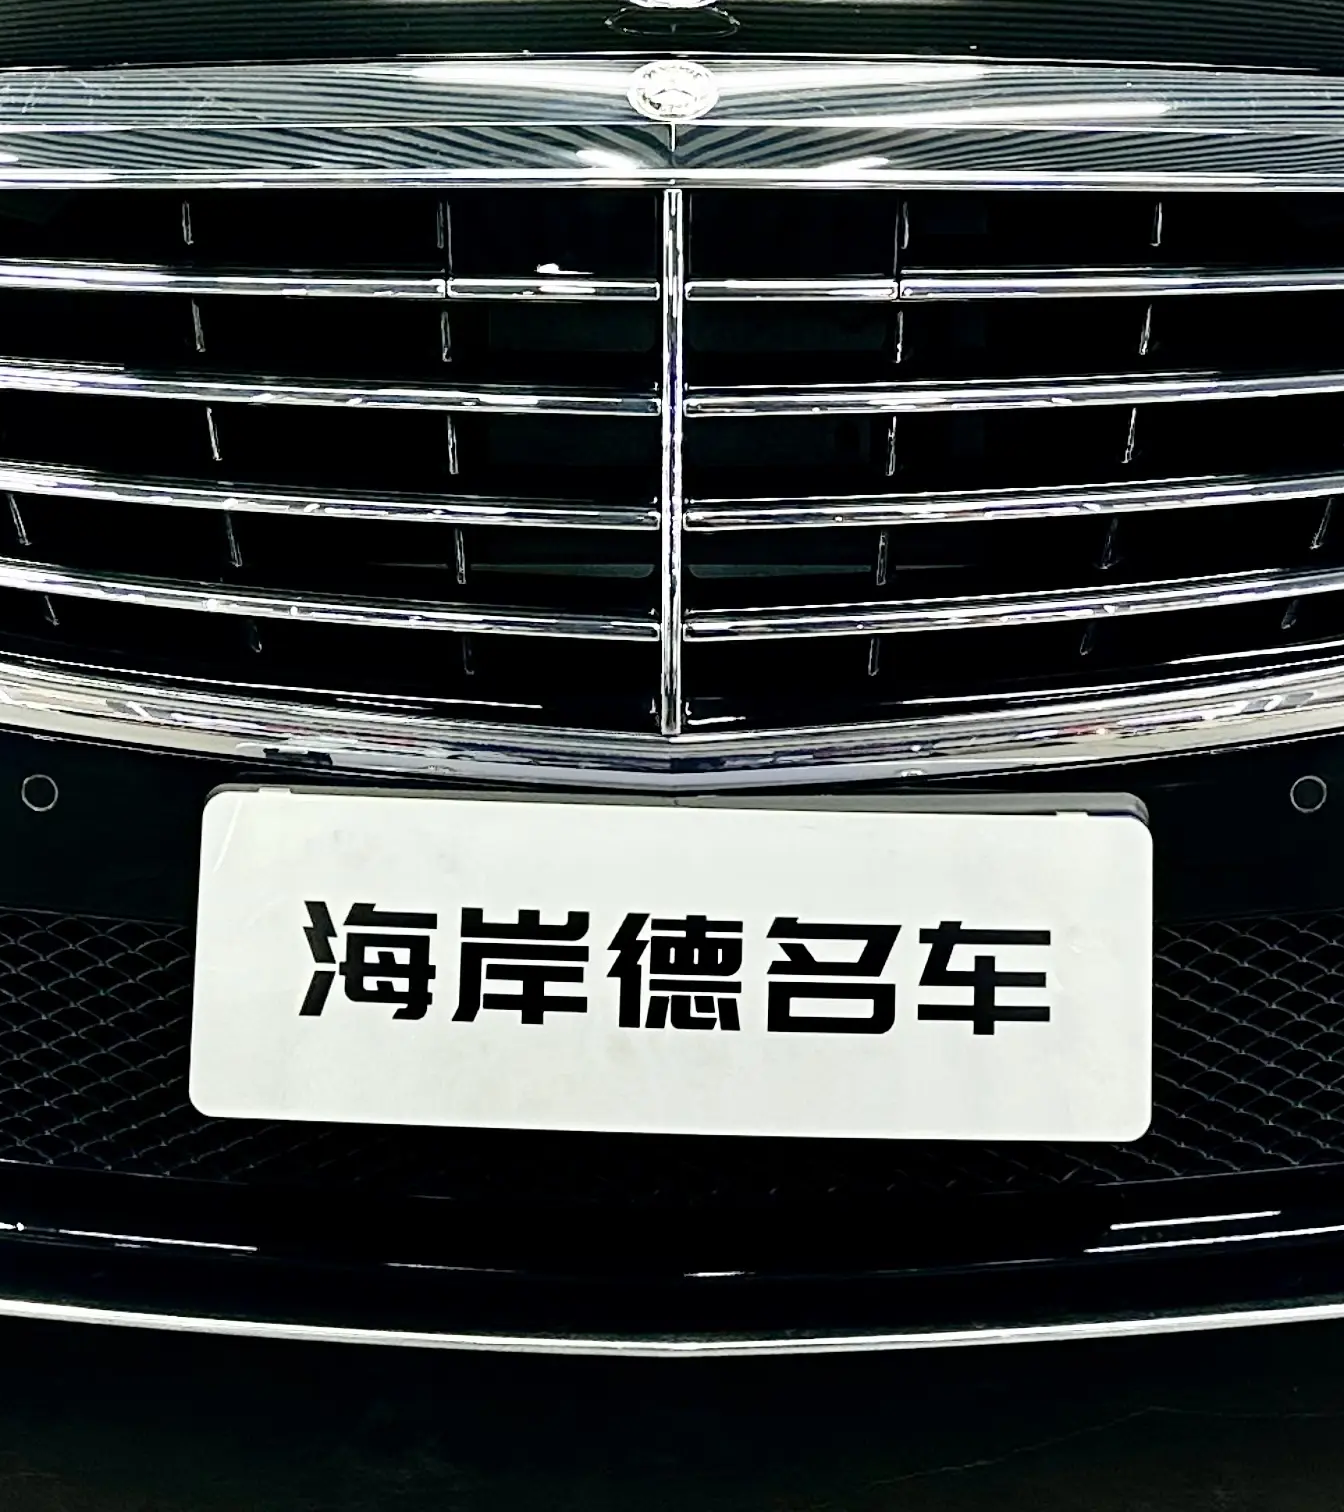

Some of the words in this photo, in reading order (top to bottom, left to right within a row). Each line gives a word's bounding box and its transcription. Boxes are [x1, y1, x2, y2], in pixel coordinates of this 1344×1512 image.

[297, 899, 1052, 1037] 海岸德名车
